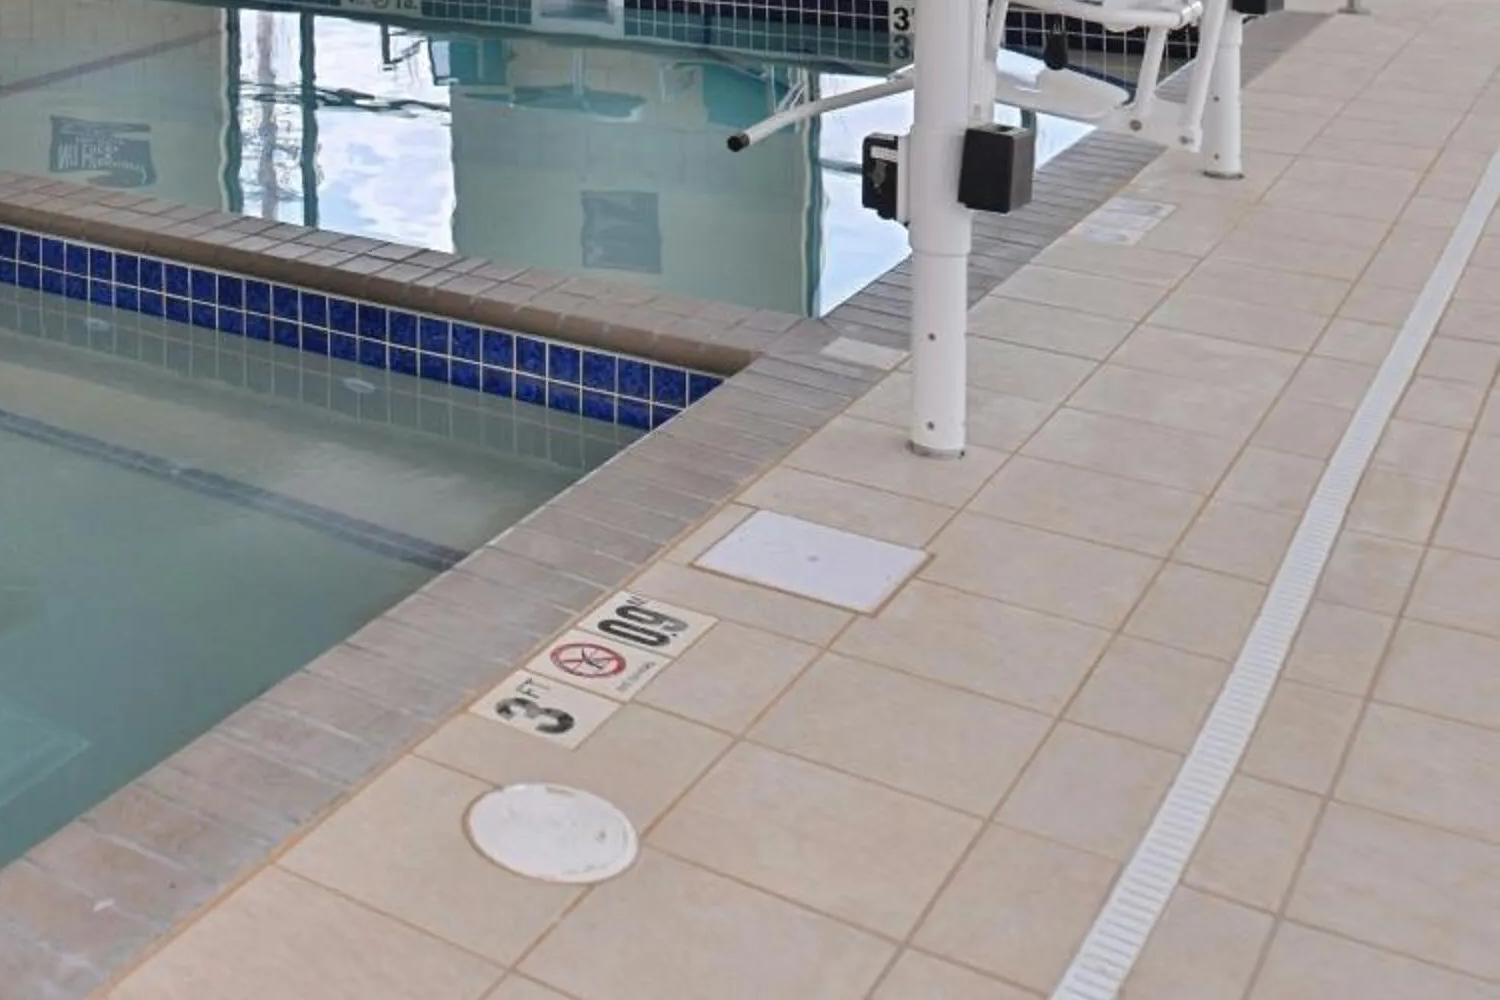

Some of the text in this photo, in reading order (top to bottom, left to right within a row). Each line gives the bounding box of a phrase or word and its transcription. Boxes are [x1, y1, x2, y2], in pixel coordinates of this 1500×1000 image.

[893, 7, 910, 31] 3
[515, 677, 550, 699] FT
[496, 697, 575, 735] 3
